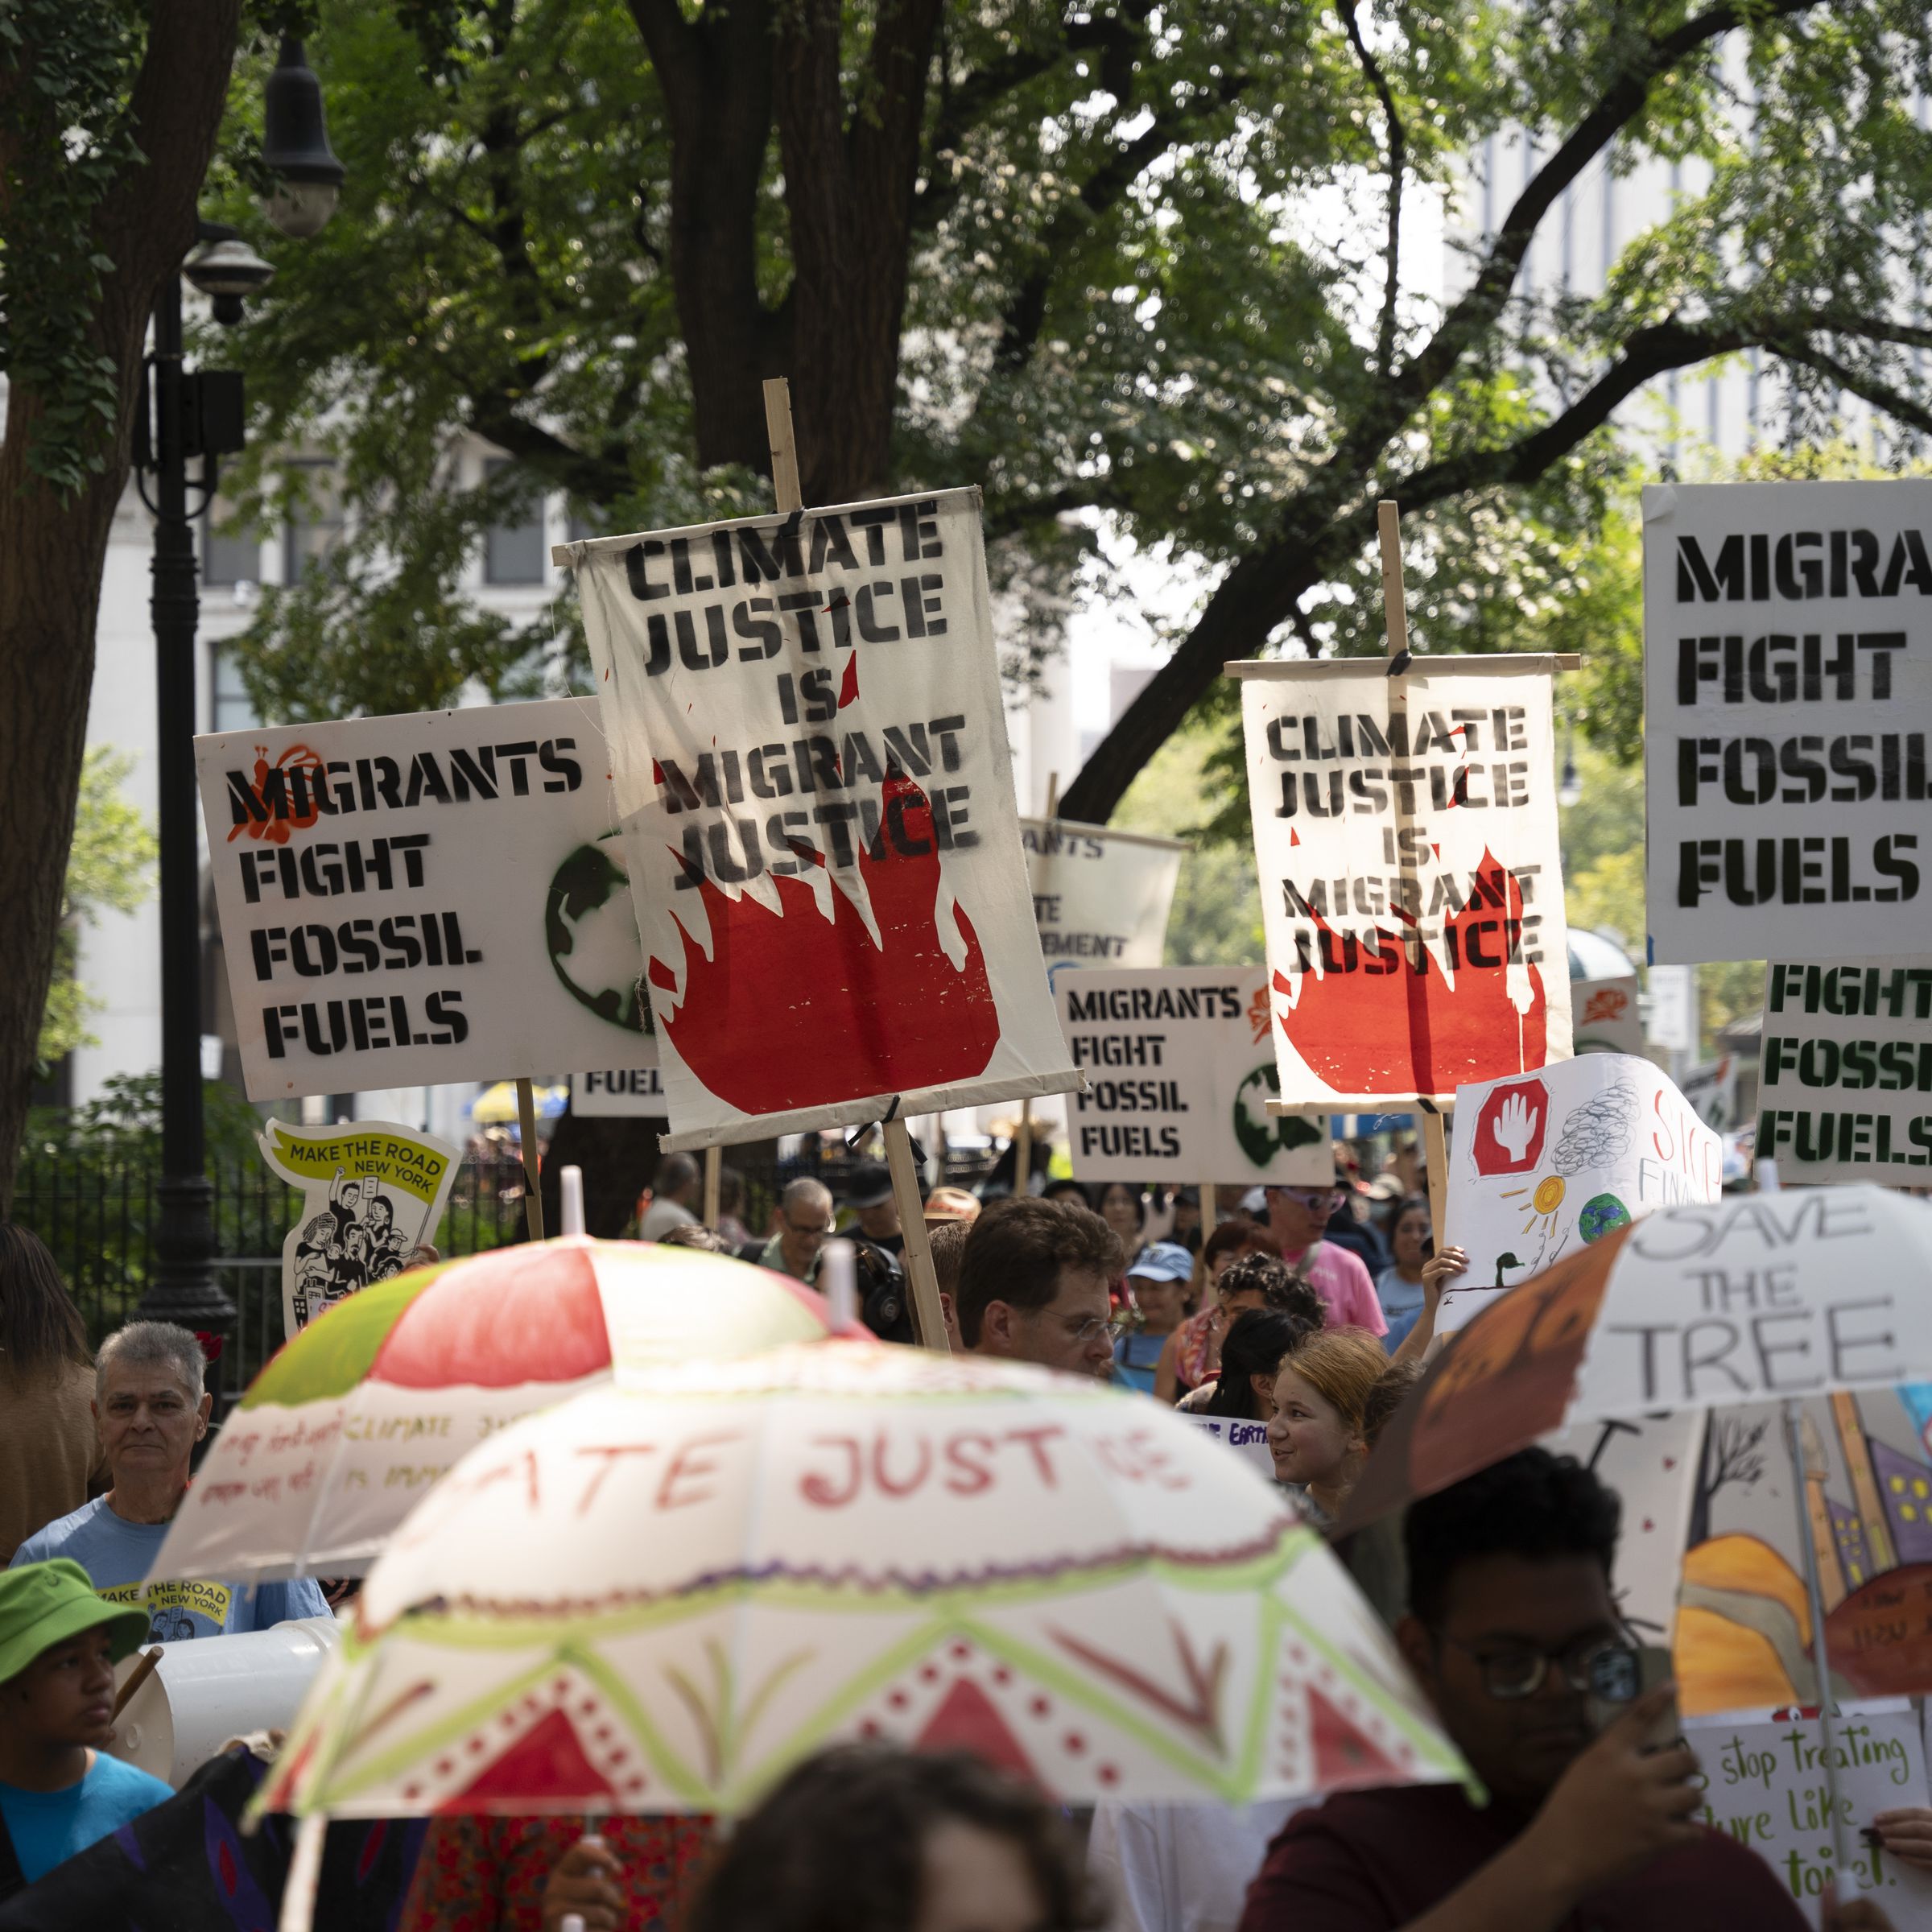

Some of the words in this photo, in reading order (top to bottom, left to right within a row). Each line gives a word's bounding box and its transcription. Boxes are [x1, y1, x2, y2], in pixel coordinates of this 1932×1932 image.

[625, 500, 943, 601] CLIMATE
[645, 574, 947, 676] JUSTICE
[777, 668, 838, 724] IS
[1678, 632, 1907, 705] FIGHT
[1266, 707, 1528, 762] CLIMATE
[226, 737, 583, 825] MIGRANTS
[658, 715, 966, 815] MIGRANT
[1275, 762, 1530, 818] JUSTICE
[1678, 733, 1932, 807] FOSSIL
[675, 785, 981, 891] JUSTICE
[1382, 827, 1430, 867] IS
[239, 833, 431, 903] FIGHT
[1282, 865, 1542, 918] MIGRANT
[1678, 834, 1920, 908] FUELS
[250, 911, 483, 980] FOSSIL
[1290, 914, 1544, 976] JUSTICE
[1067, 986, 1241, 1022] MIGRANTS
[1770, 964, 1932, 1018] FIGHT
[262, 990, 469, 1059] FUELS
[1072, 1034, 1166, 1067] FIGHT
[1077, 1080, 1189, 1113] FOSSIL
[290, 1144, 341, 1162] MAKE
[343, 1140, 382, 1158] THE
[386, 1142, 441, 1176] ROAD
[1081, 1125, 1181, 1158] FUELS
[355, 1160, 391, 1174] NEW
[394, 1164, 434, 1195] YORK
[1632, 1194, 1876, 1261] SAVE
[1682, 1262, 1803, 1314] THE
[1606, 1294, 1906, 1402] TREE
[147, 1582, 177, 1598] THE
[181, 1580, 226, 1604] ROAD
[162, 1595, 190, 1606] NEW
[193, 1596, 223, 1616] YORK
[1720, 1735, 1777, 1790] stop
[1781, 1843, 1897, 1899] toiet.
